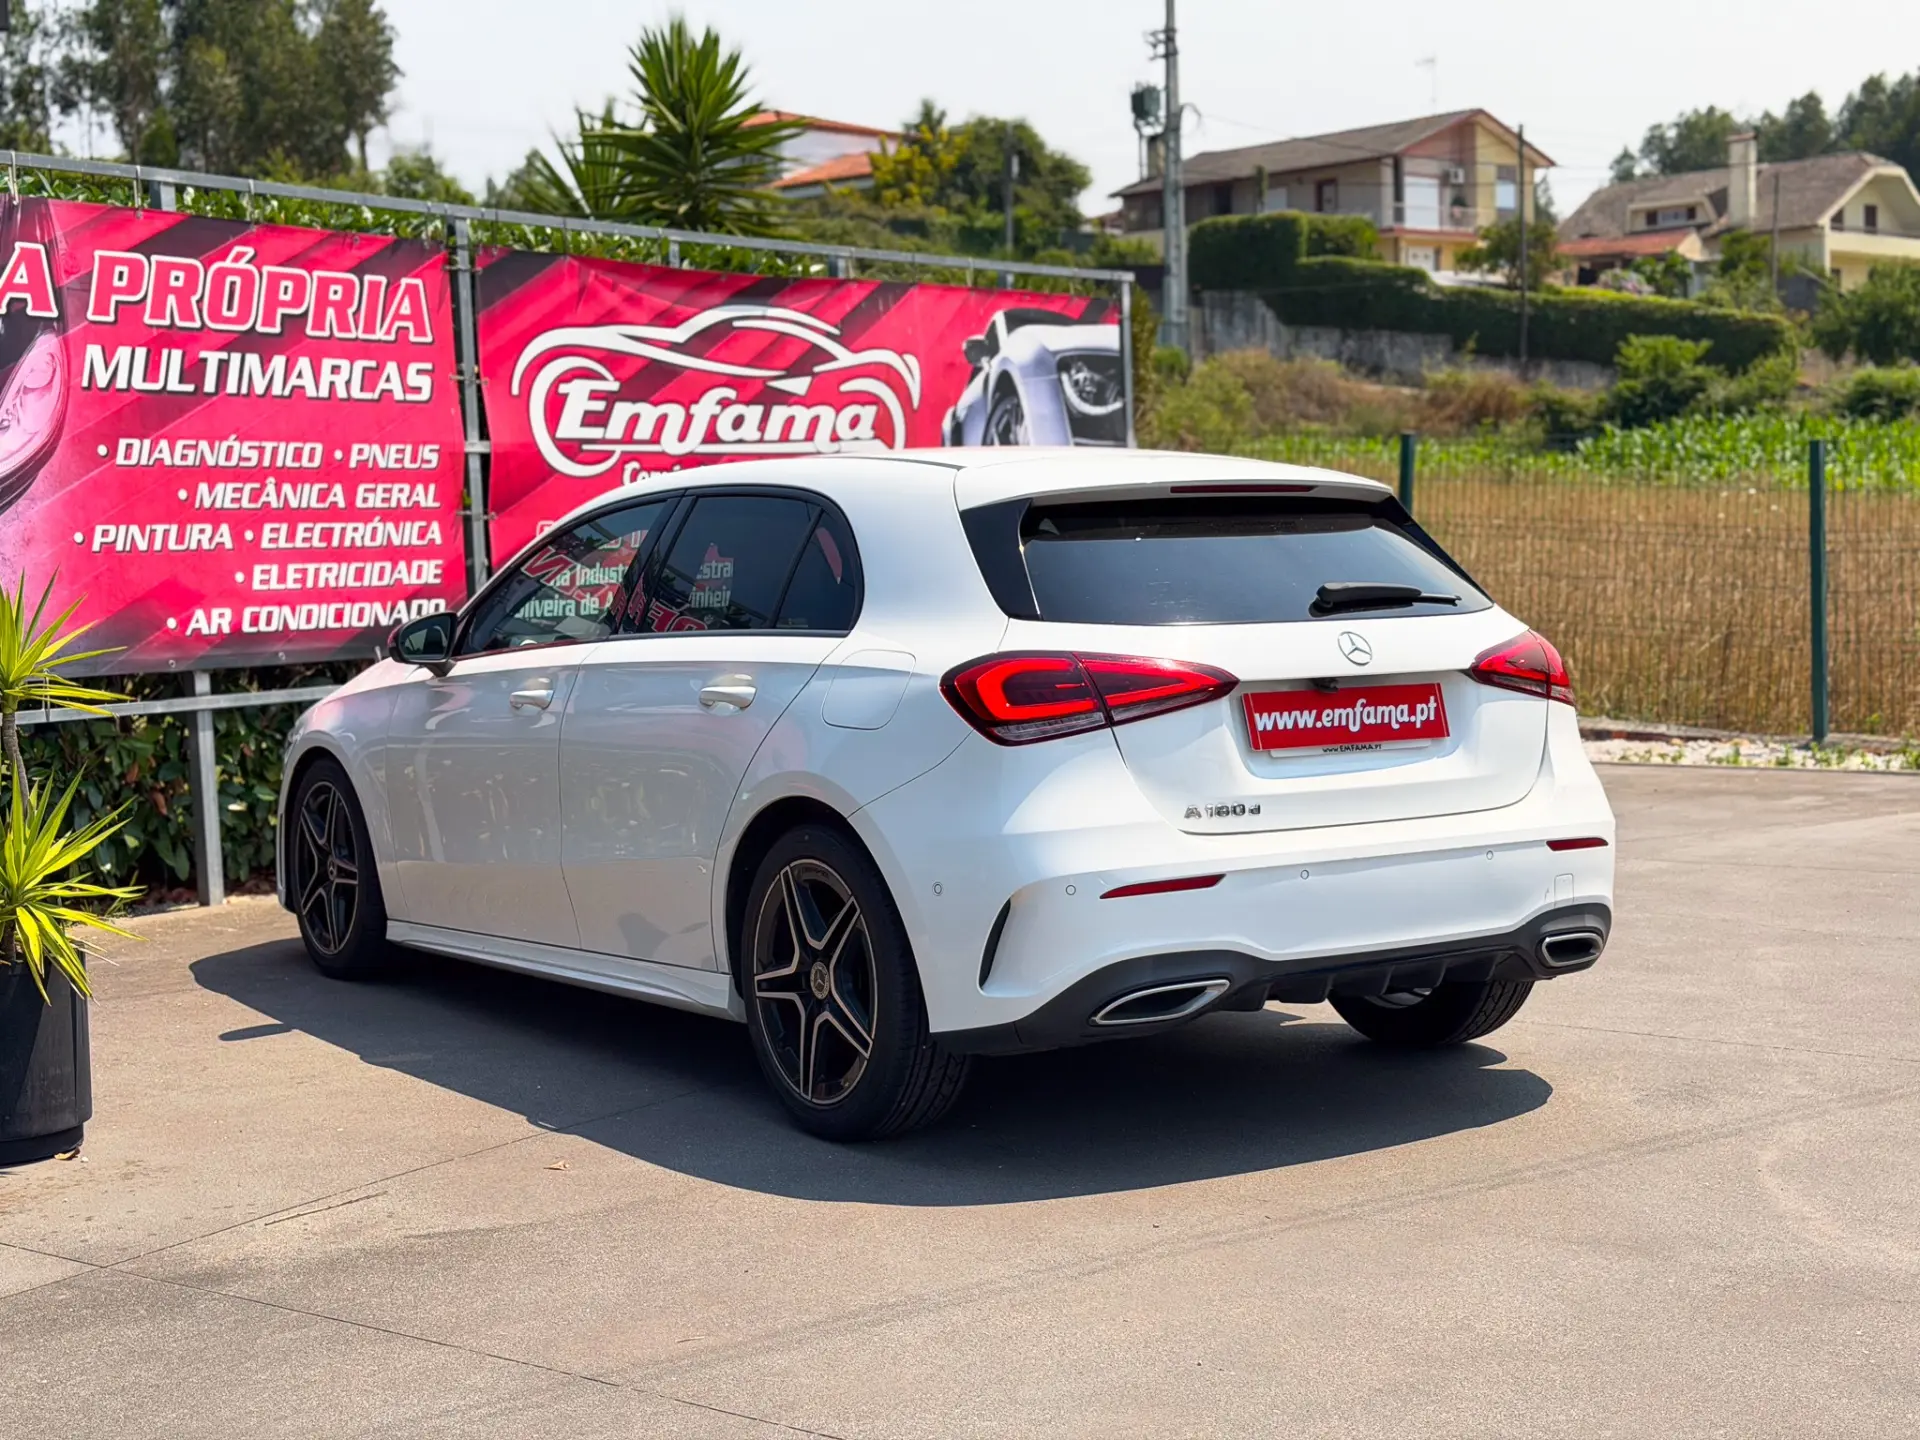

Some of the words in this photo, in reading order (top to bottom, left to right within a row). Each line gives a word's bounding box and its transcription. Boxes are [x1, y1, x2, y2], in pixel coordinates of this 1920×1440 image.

[87, 246, 434, 343] PRÓPRIA
[82, 344, 434, 401] MULTIMARCAS
[555, 379, 878, 455] Emfama
[116, 436, 323, 469] DIAGNÓSTICO
[349, 443, 440, 469] PNEUS
[194, 478, 346, 508] MECÂNICA
[355, 484, 441, 508] GERAL
[92, 524, 233, 552] PINTURA
[261, 517, 442, 549] ELECTRÓNICA
[252, 560, 443, 590] ELETRICIDADE
[580, 592, 599, 615] de
[185, 608, 231, 636] AR
[1254, 696, 1437, 732] www.emfama.pt
